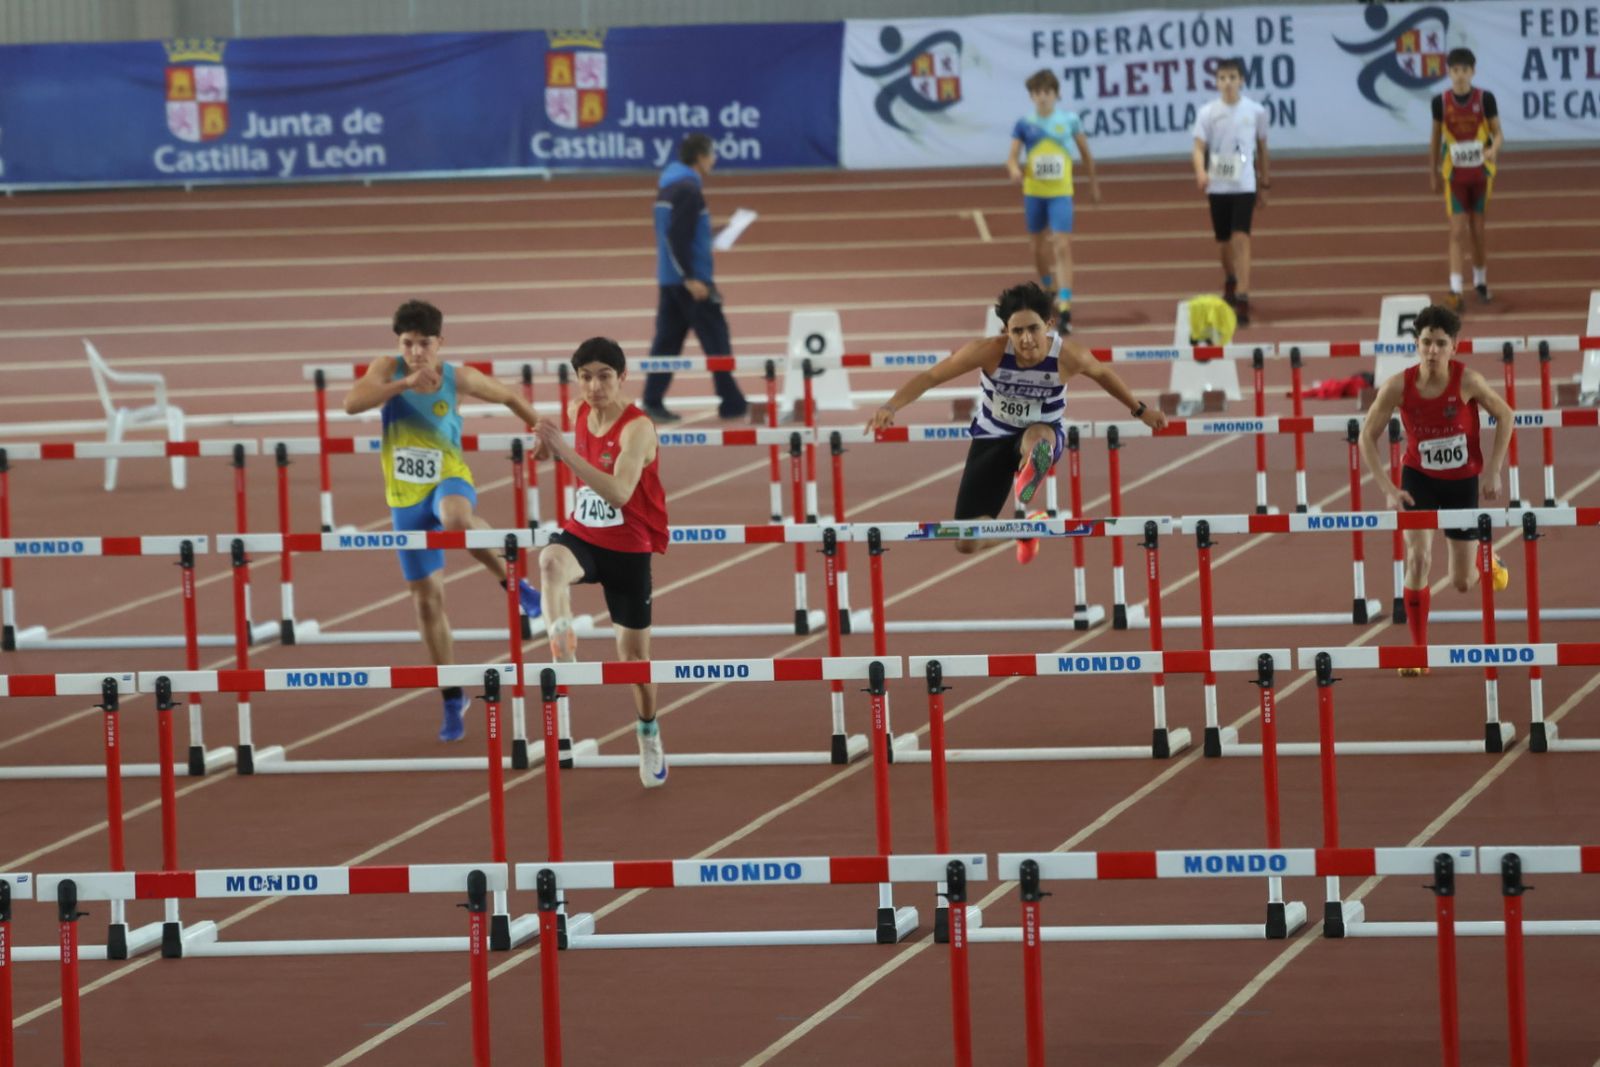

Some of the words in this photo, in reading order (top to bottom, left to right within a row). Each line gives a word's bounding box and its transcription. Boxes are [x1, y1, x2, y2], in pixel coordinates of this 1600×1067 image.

[1520, 8, 1600, 37] FEDE
[1031, 14, 1234, 58] FEDERACIÓN
[1257, 16, 1295, 45] DE
[1064, 54, 1295, 99] TLETISMO
[619, 99, 709, 127] Junta
[719, 101, 761, 127] de
[1523, 91, 1556, 119] DE
[1563, 90, 1600, 119] CA
[242, 111, 332, 138] Junta
[343, 108, 384, 134] de
[1080, 104, 1197, 138] CASTILLA
[1260, 94, 1297, 128] ÓN
[531, 132, 645, 159] Castilla
[653, 138, 673, 167] y
[154, 145, 270, 173] Castilla
[277, 148, 298, 178] y
[307, 139, 386, 169] León
[1135, 350, 1179, 359] MONDO
[1374, 343, 1416, 353] MOND
[640, 360, 692, 370] MONDO
[885, 355, 937, 365] MONDO
[996, 383, 1053, 397] RACING
[1000, 401, 1030, 416] 2691
[1213, 421, 1264, 432] MONDO
[1488, 415, 1543, 425] MNDO
[659, 433, 706, 445] ONDO
[924, 427, 971, 438] MOND
[1424, 446, 1463, 464] 1406
[396, 456, 436, 478] 2883
[580, 499, 616, 520] 1403
[1307, 515, 1378, 529] MONDO
[339, 534, 408, 548] MONDO
[672, 529, 727, 542] ONDO
[15, 540, 84, 555] MONDO
[1058, 656, 1142, 672] MONDO
[1450, 647, 1535, 664] MONDO
[675, 663, 749, 679] MONDO
[286, 671, 368, 689] MONDO
[700, 861, 802, 883] MONDO
[1184, 853, 1288, 875] MONDO
[226, 874, 318, 892] MONDO
